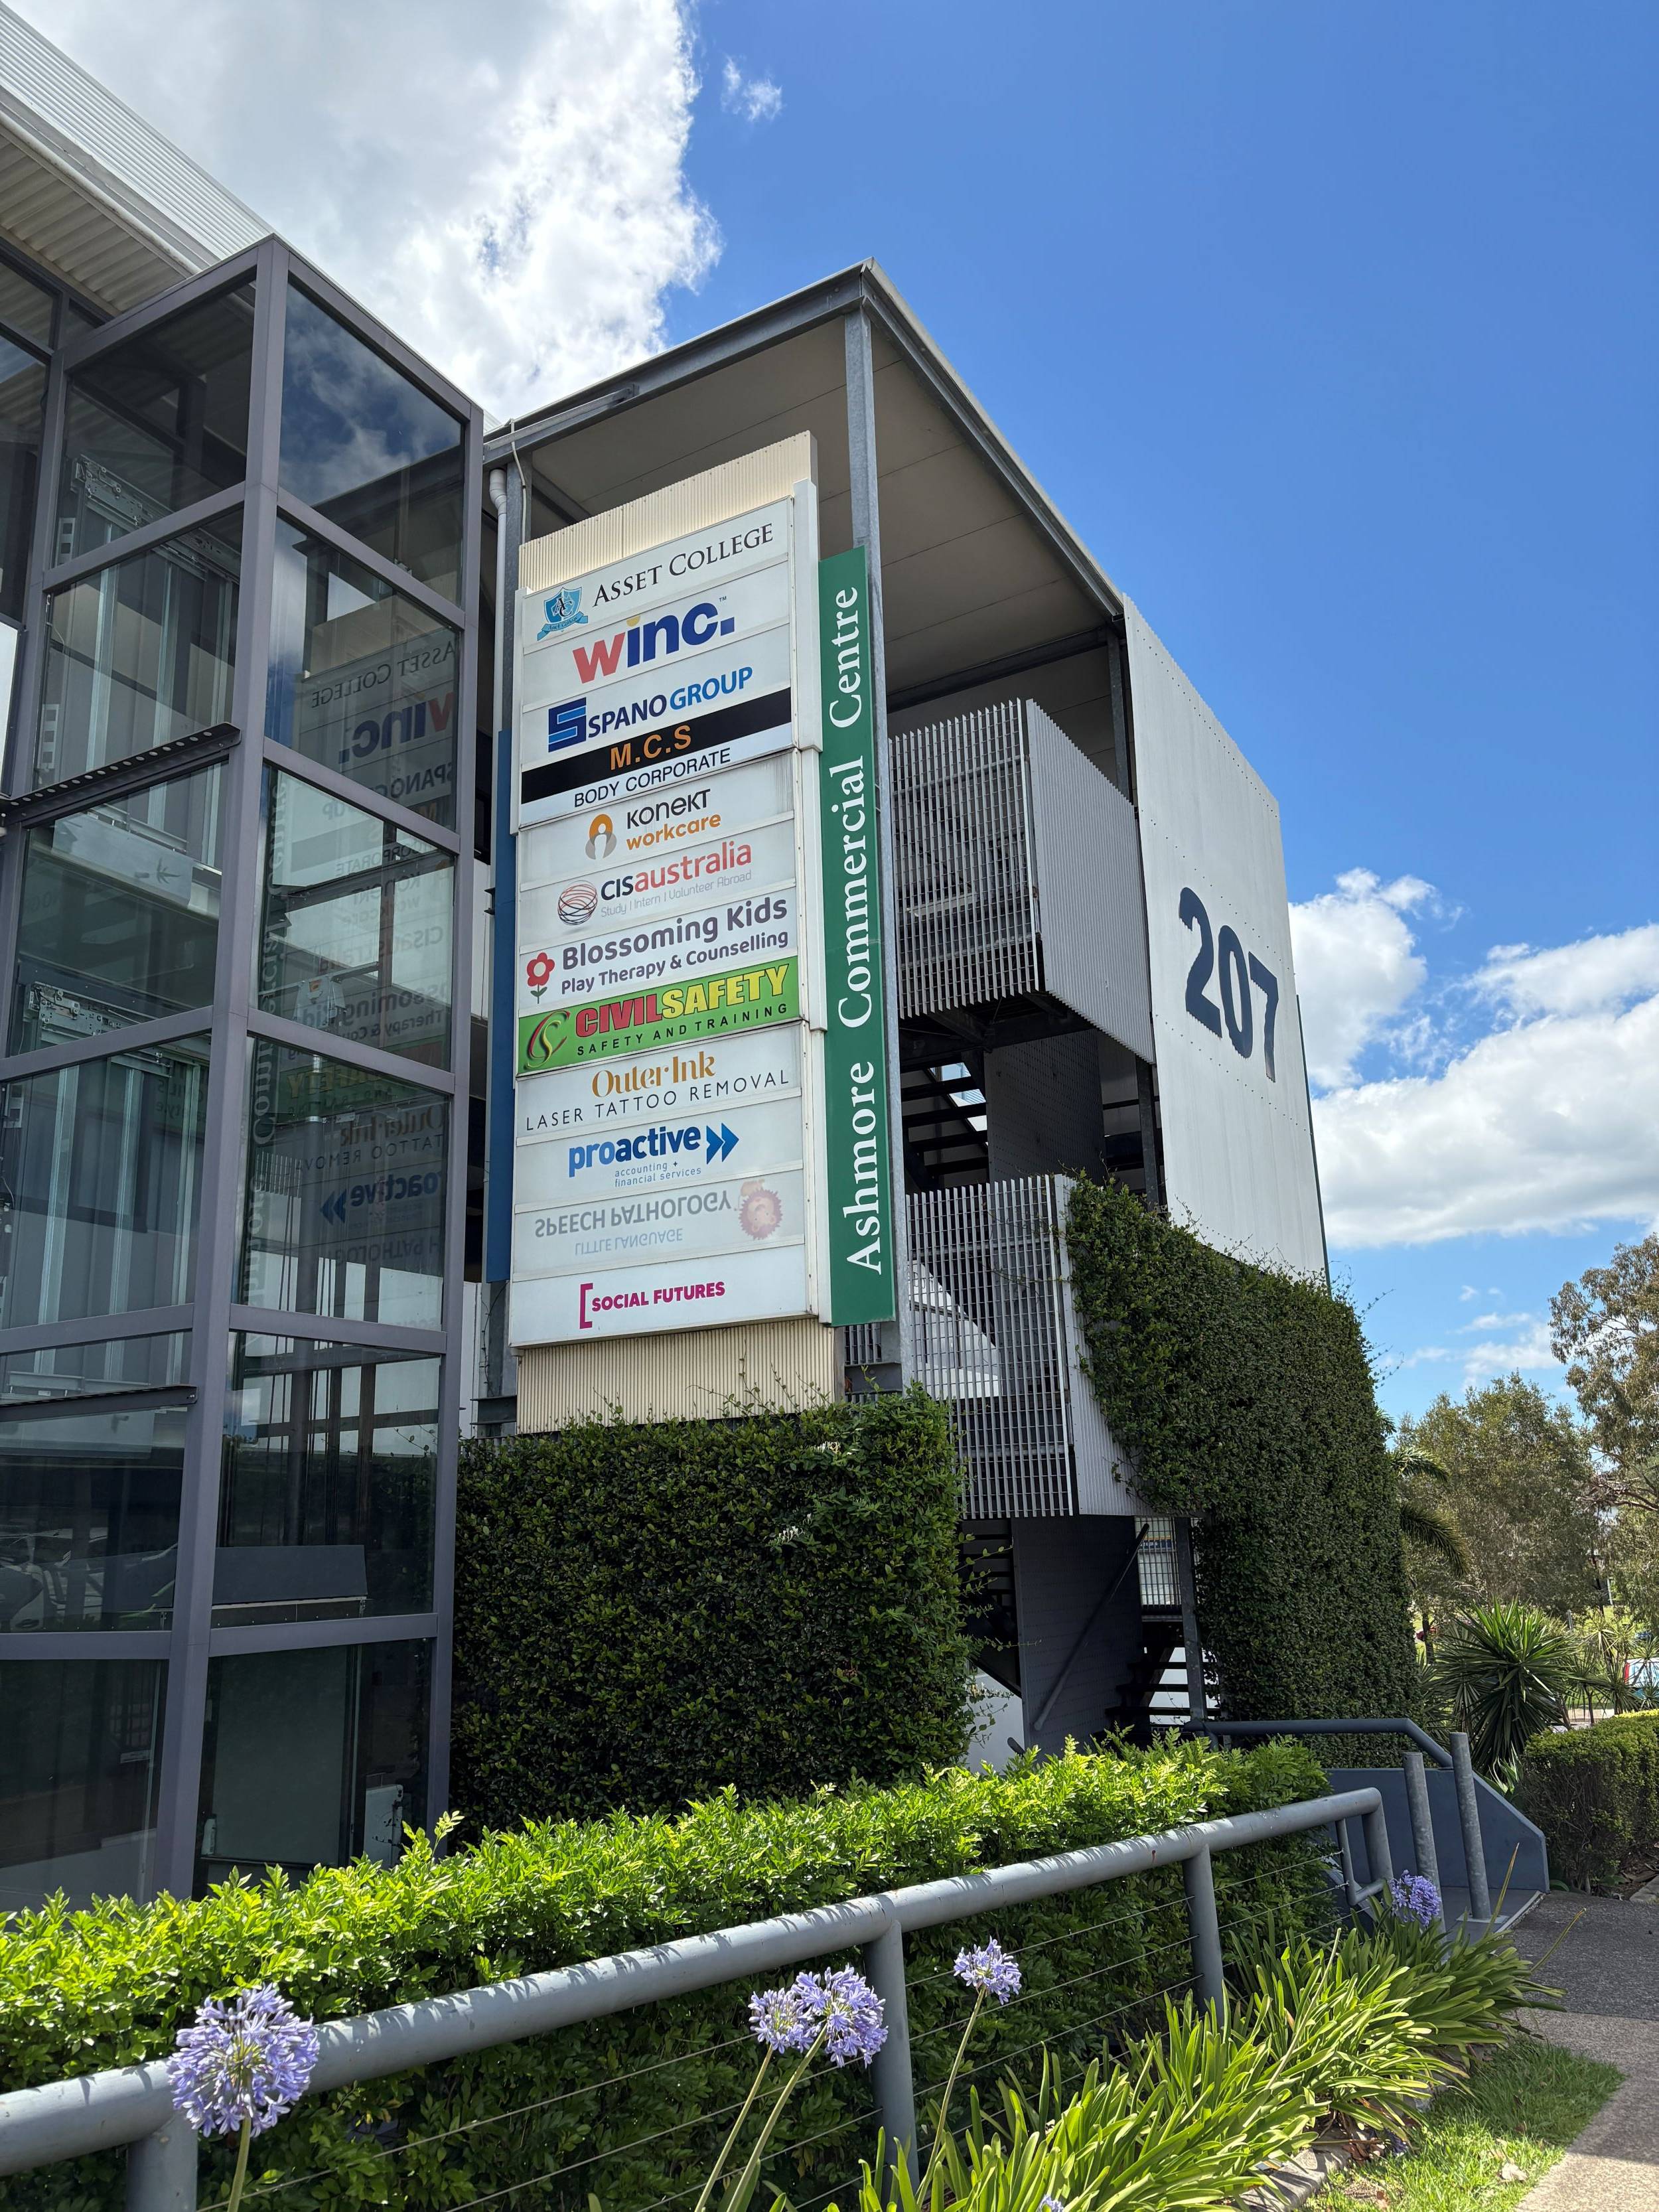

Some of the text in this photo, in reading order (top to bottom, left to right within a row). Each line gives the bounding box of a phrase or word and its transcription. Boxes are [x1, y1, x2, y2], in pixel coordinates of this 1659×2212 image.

[593, 523, 773, 607] ASSET COLLEGE
[830, 587, 862, 728] Centre
[575, 747, 731, 808] BODY CORPORATE
[611, 725, 691, 771] M.C.S
[626, 814, 721, 850] workcare
[601, 903, 626, 917] Study
[634, 895, 661, 909] Intern
[669, 881, 715, 899] Volunteer
[717, 870, 752, 888] Abroad
[829, 755, 872, 1028] Commercial
[561, 931, 789, 995] Play Therapy & Counselling
[562, 897, 787, 970] Blossoming Kids
[1179, 887, 1279, 1083] 207
[577, 1003, 788, 1056] SAFETY AND TRAINING
[526, 1069, 789, 1131] LASER TATTOO REMOVAL
[569, 1126, 701, 1178] proactive
[614, 1161, 668, 1177] accounting
[614, 1167, 701, 1187] financial services
[843, 1061, 882, 1276] Ashmore
[592, 1281, 725, 1312] SOCIAL FUTURES
